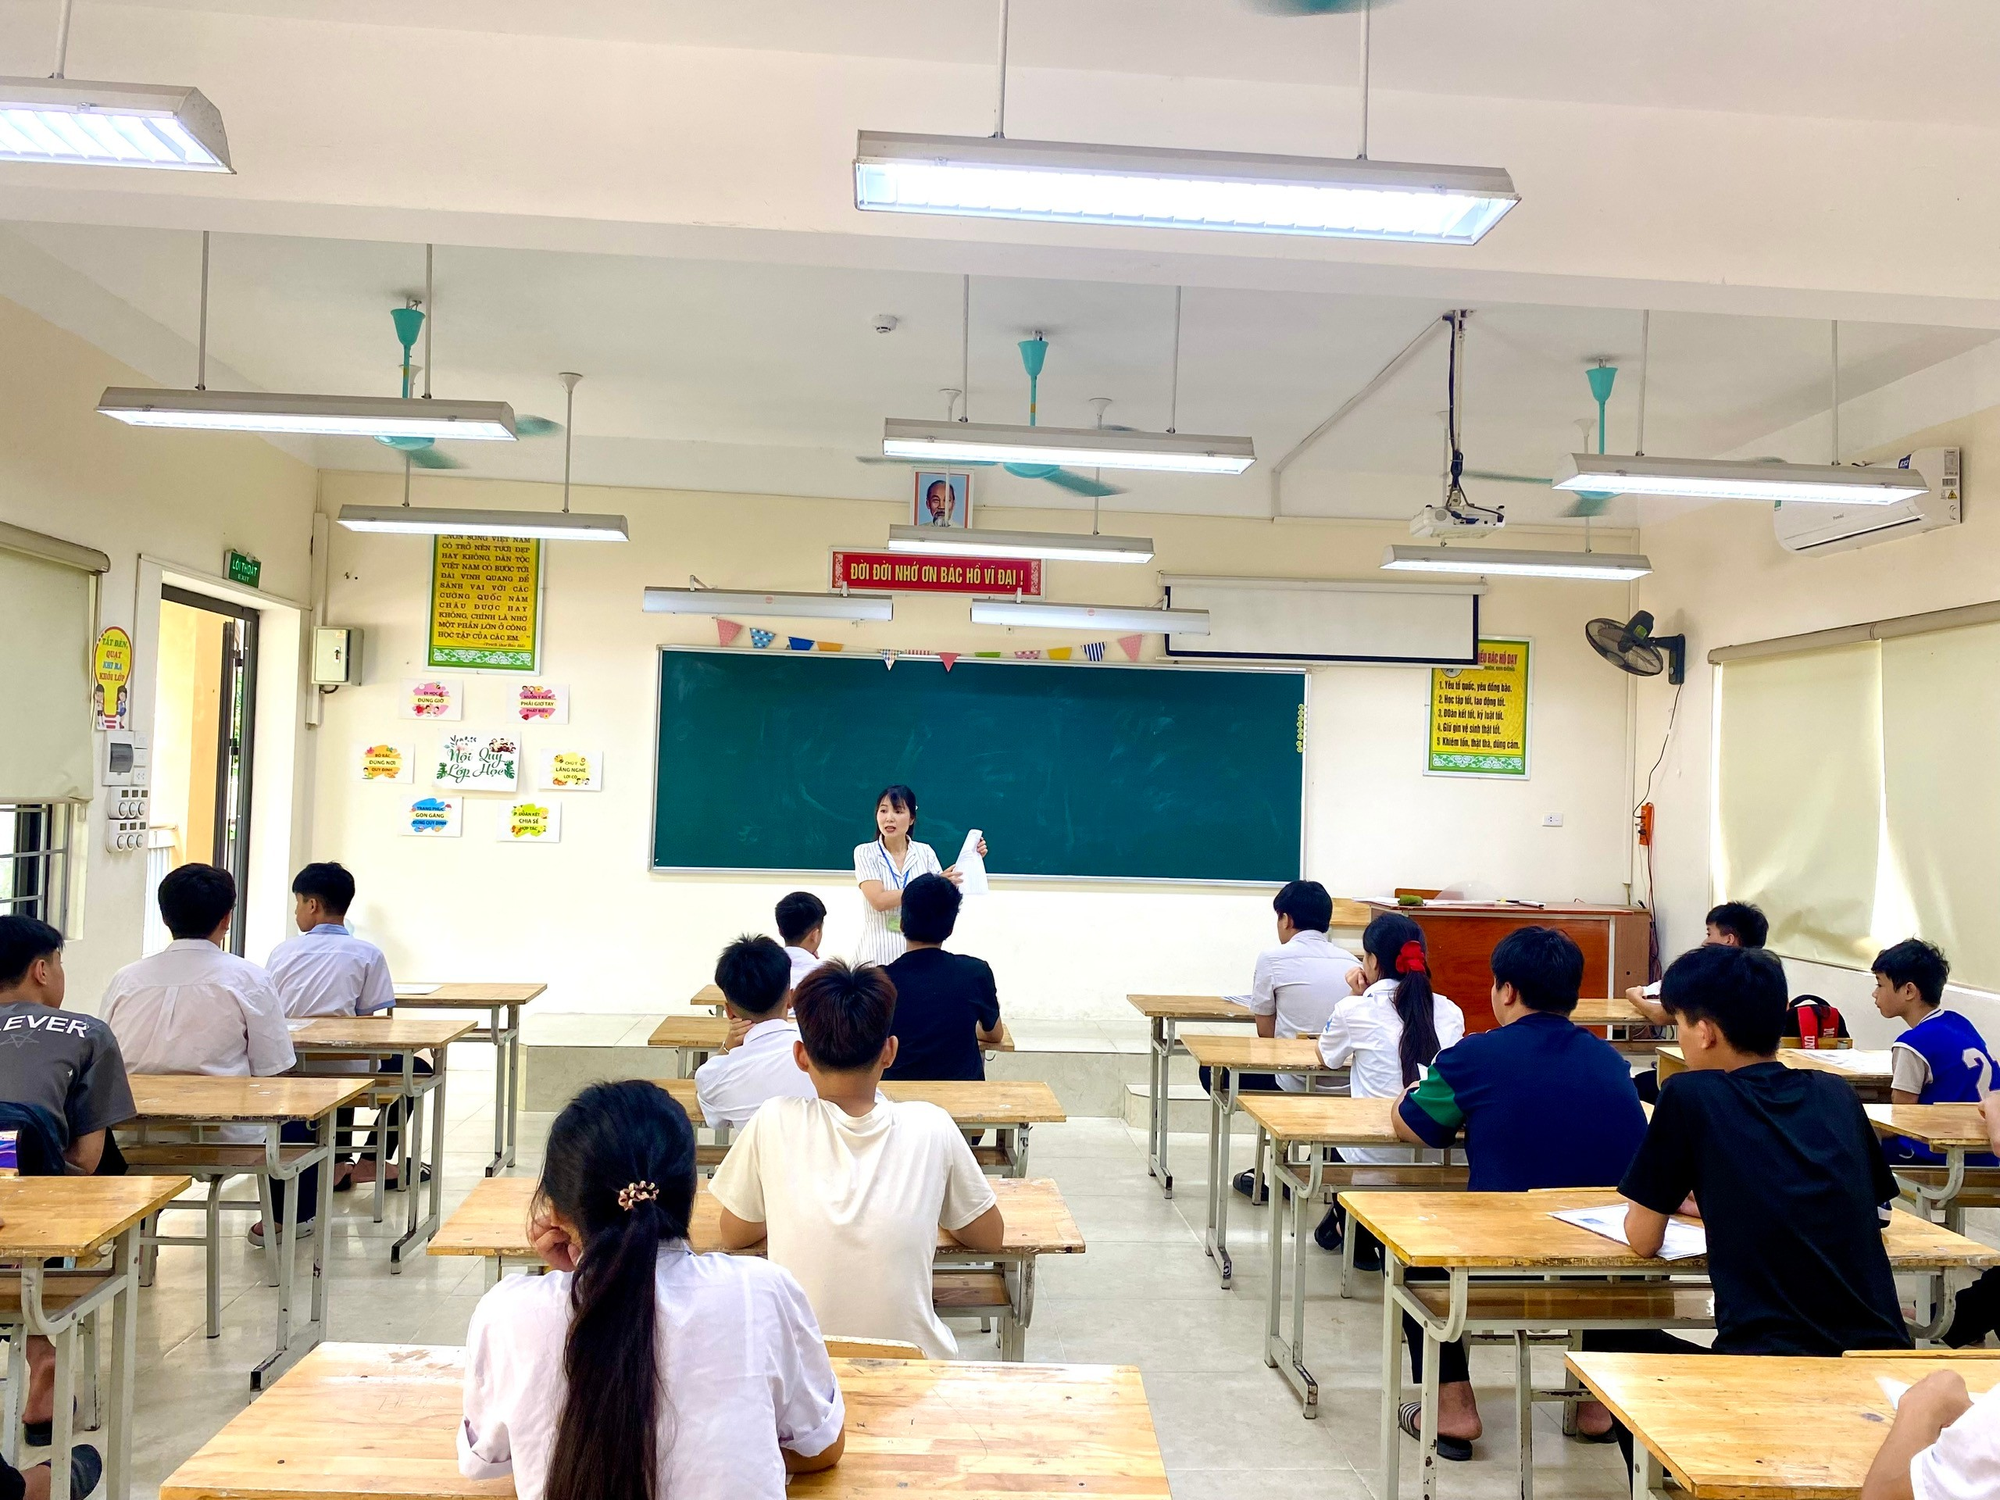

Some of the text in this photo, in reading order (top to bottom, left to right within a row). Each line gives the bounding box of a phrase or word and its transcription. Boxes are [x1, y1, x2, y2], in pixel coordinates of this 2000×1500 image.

[238, 574, 249, 582] EXIT
[851, 560, 870, 580] ĐỜI
[873, 561, 891, 581] ĐỜI
[895, 561, 919, 582] NHỚ
[922, 566, 936, 582] ƠN
[940, 564, 962, 584] BÁC
[966, 563, 981, 584] HỒ
[984, 565, 995, 584] VĨ
[998, 569, 1016, 588] ĐẠI
[102, 635, 113, 646] TẮT
[473, 631, 488, 640] CỦA
[106, 650, 122, 660] QUẠT
[1488, 651, 1498, 664] BÁC
[99, 671, 125, 682] KHỎI LỚP
[1445, 681, 1454, 690] Yêu
[1477, 682, 1486, 691] yêu
[1487, 682, 1500, 692] đồng
[1445, 695, 1454, 706] Học
[1484, 697, 1495, 707] động
[1470, 724, 1480, 733] sinh
[1442, 737, 1459, 746] Khiêm
[1493, 740, 1506, 749] dũng
[447, 747, 503, 768] Nội Quy
[448, 763, 504, 783] Lớp Học
[0, 1015, 89, 1038] EVER
